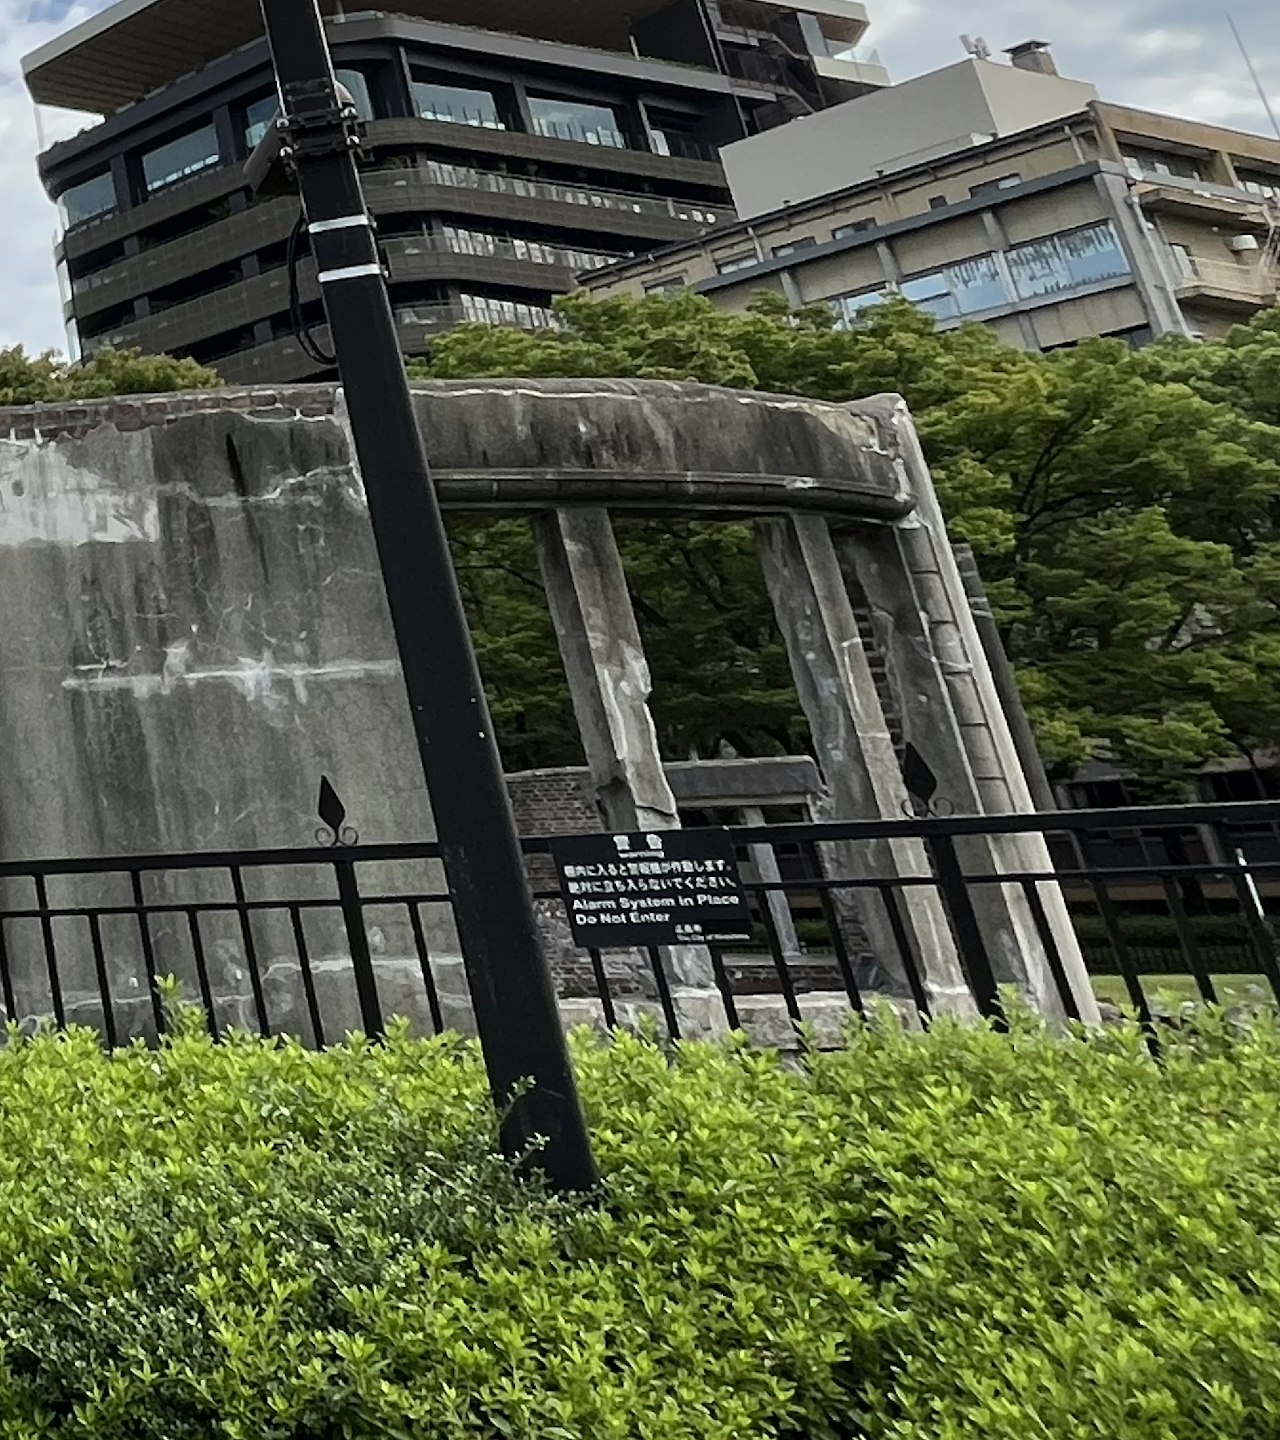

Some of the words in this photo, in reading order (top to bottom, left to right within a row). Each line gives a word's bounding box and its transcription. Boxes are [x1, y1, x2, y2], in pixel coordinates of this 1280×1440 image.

[572, 899, 616, 910] Alarm
[619, 897, 675, 910] System
[697, 893, 739, 905] Place
[576, 913, 597, 925] Do
[600, 912, 627, 924] Not
[629, 911, 670, 923] Enter
